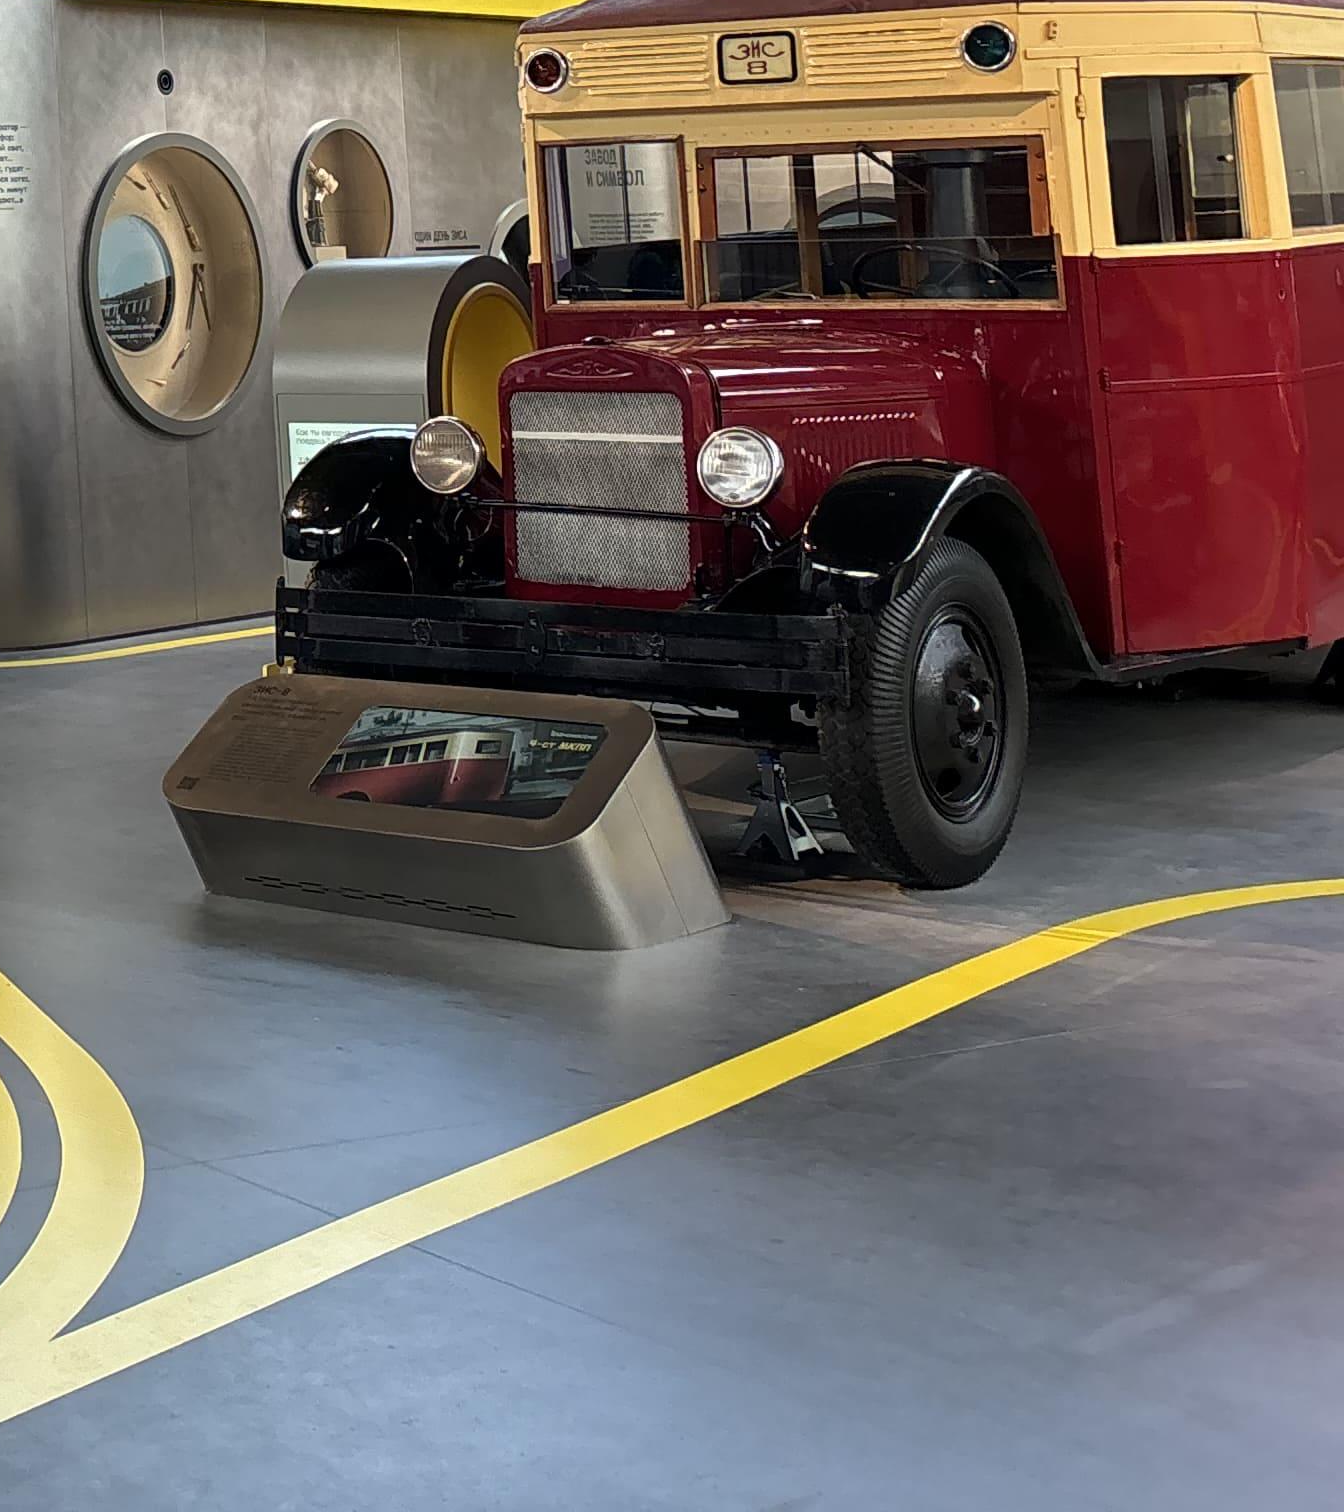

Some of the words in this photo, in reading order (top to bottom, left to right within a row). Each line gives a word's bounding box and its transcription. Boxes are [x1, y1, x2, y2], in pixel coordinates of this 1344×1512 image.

[728, 39, 785, 61] ЗИС
[746, 60, 768, 76] 8
[583, 148, 617, 168] ЗАВОД
[585, 170, 594, 188] И
